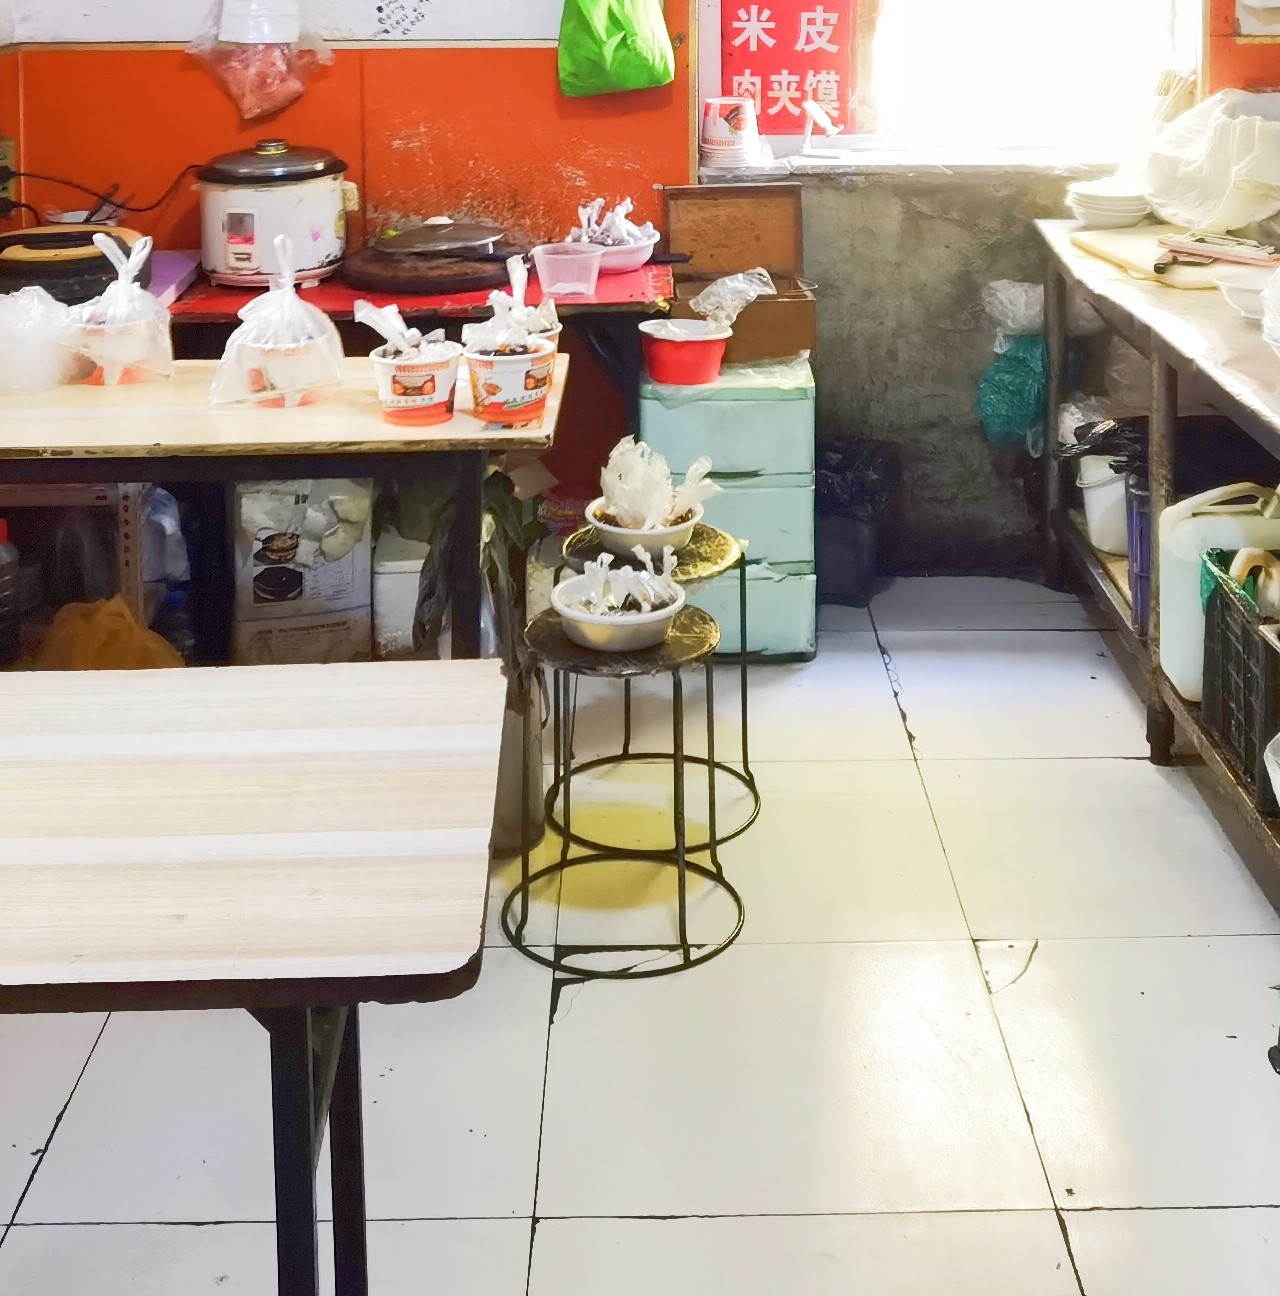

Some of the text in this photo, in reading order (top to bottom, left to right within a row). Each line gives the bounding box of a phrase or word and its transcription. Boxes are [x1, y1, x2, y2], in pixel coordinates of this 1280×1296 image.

[730, 5, 840, 54] 米皮
[732, 68, 840, 118] 肉夹馍
